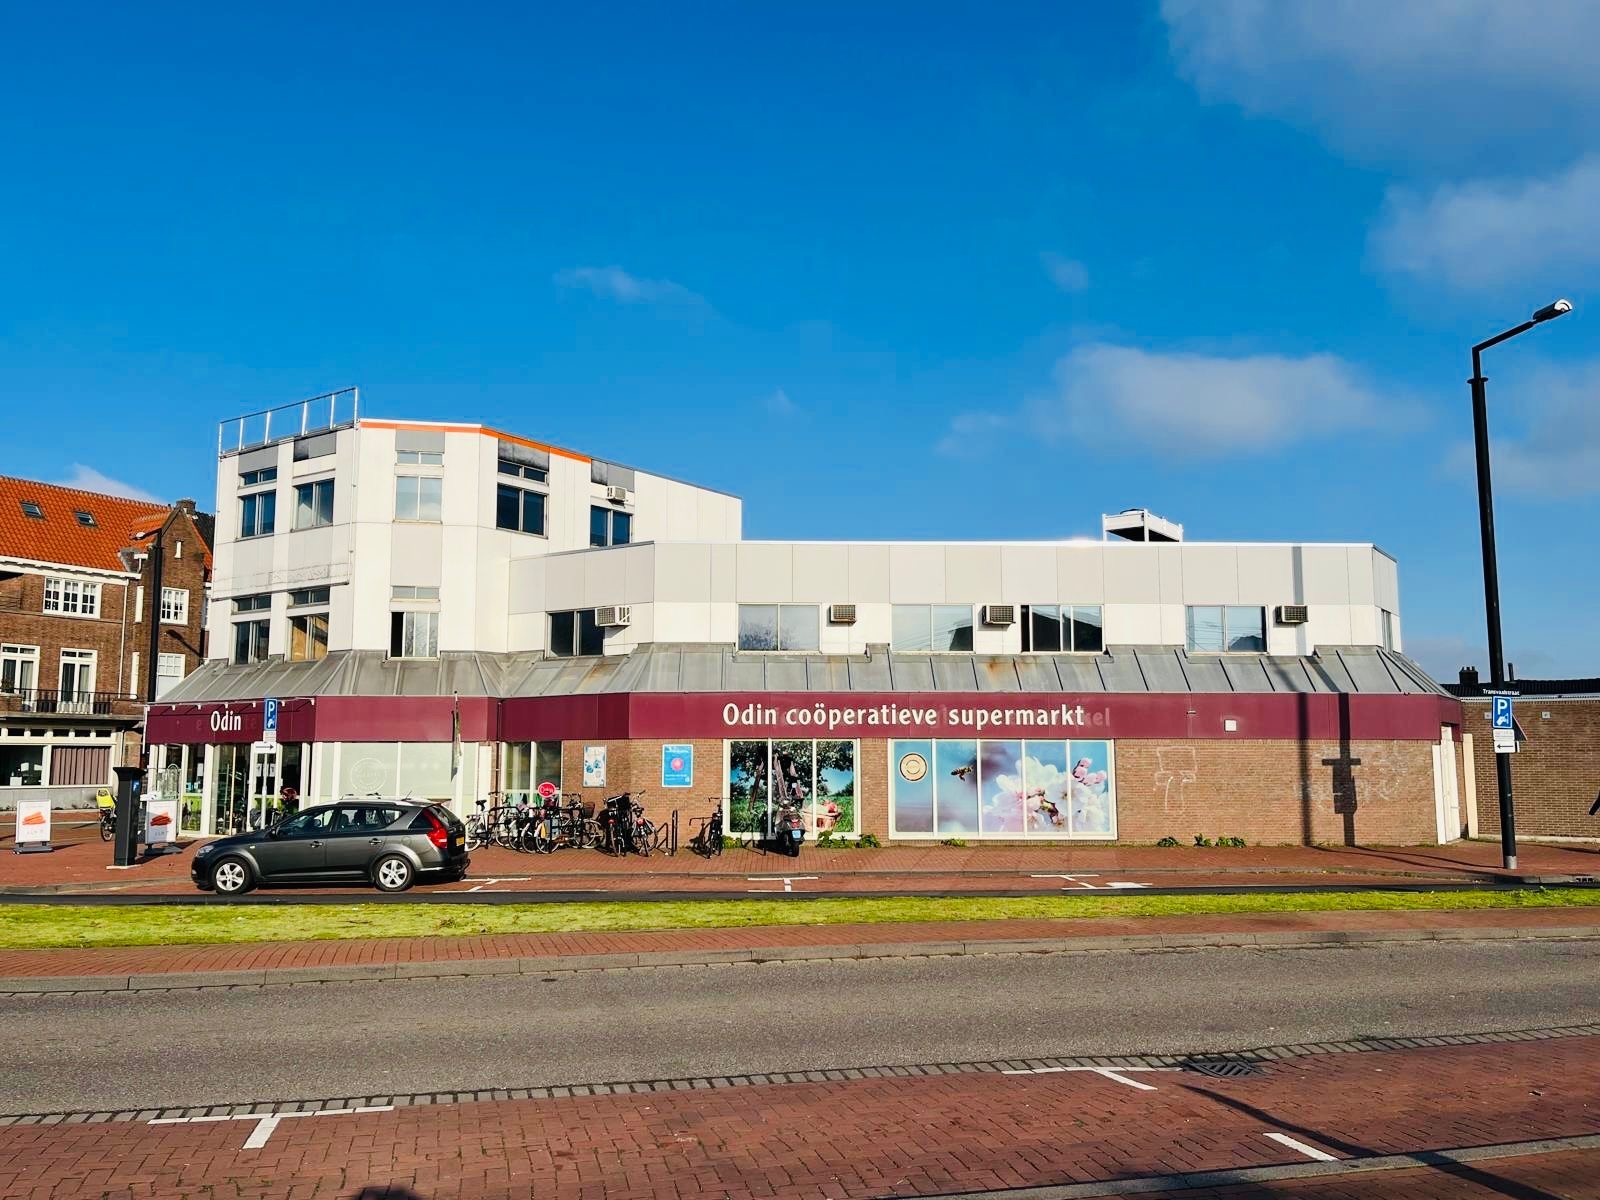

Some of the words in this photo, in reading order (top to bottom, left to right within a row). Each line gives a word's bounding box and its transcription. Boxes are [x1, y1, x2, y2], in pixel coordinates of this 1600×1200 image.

[268, 701, 275, 717] P
[1497, 699, 1508, 715] P
[210, 710, 242, 731] Odin
[722, 702, 777, 725] Odin
[785, 702, 938, 730] coöperatieve
[948, 703, 1085, 731] supermarkt
